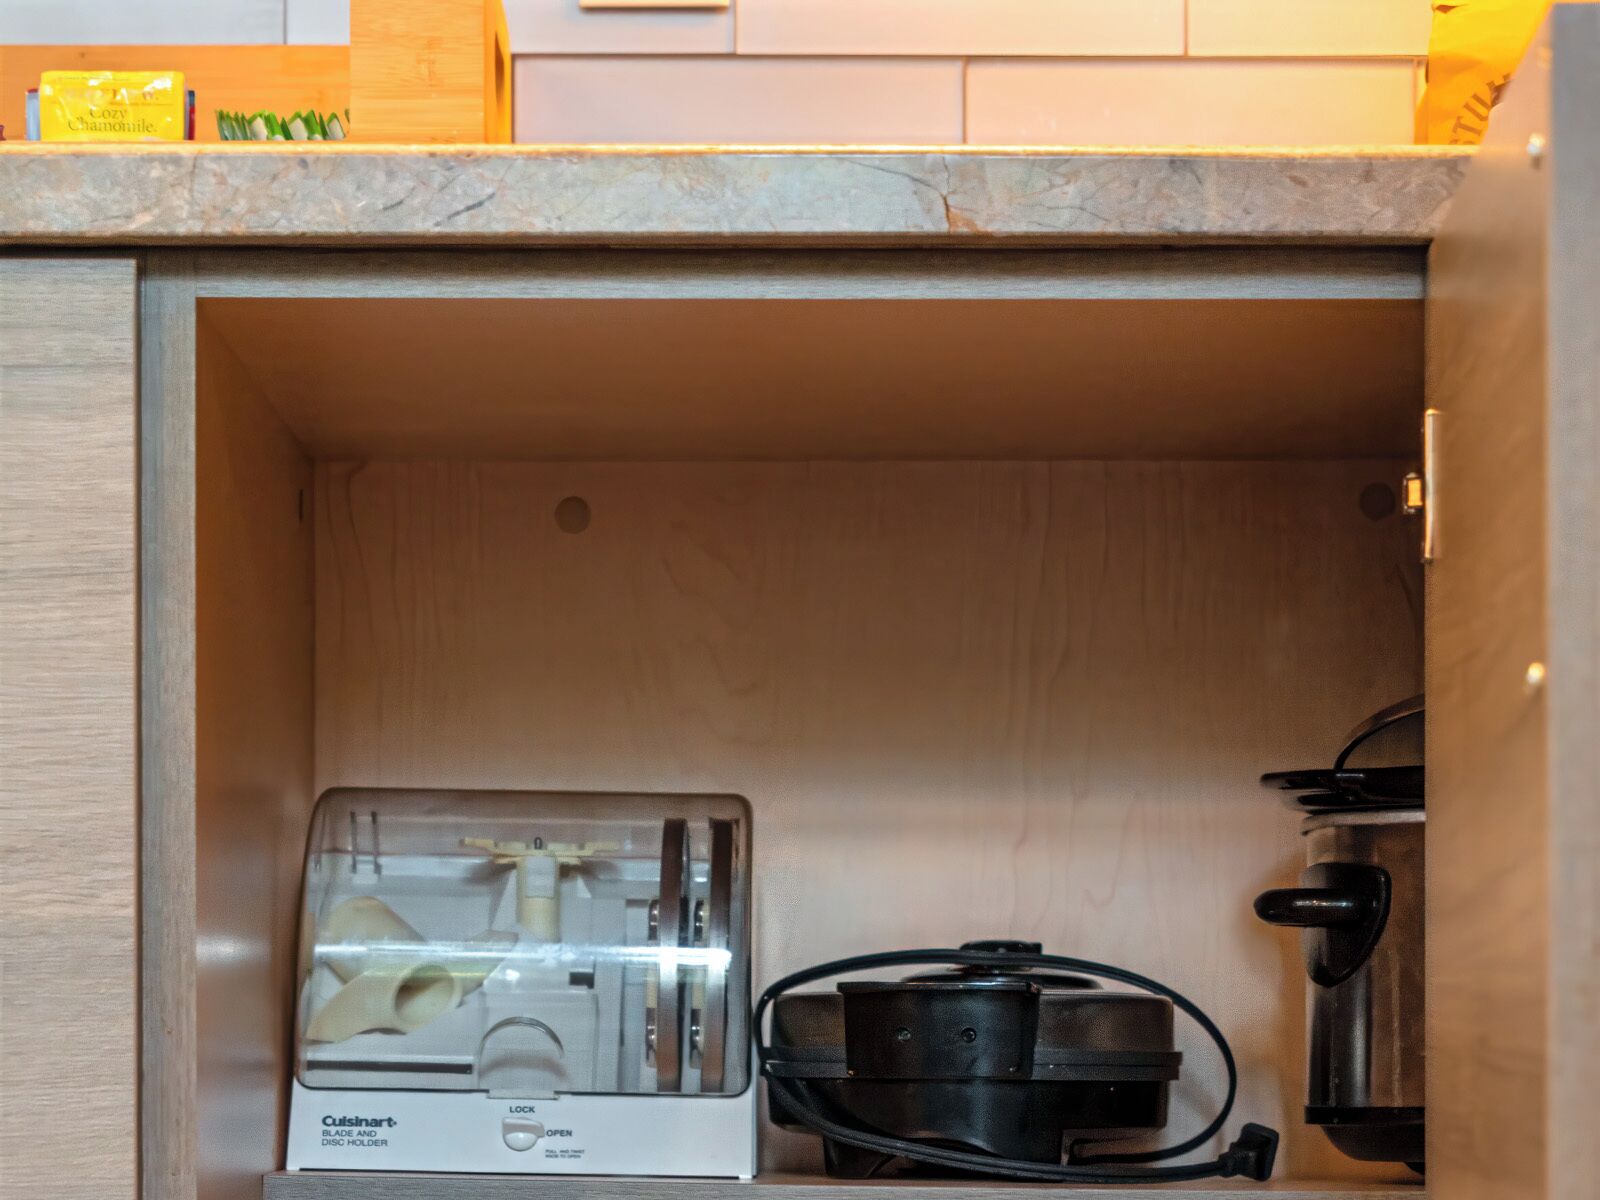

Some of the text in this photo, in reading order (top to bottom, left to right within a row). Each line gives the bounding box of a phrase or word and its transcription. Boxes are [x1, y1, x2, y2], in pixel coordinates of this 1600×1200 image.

[89, 108, 126, 120] Cozy
[509, 1105, 536, 1114] LOCK
[321, 1115, 395, 1128] Cuisinart
[322, 1129, 377, 1138] BLADE AND
[545, 1129, 573, 1137] OPEN
[321, 1138, 388, 1147] DISC HOLDER
